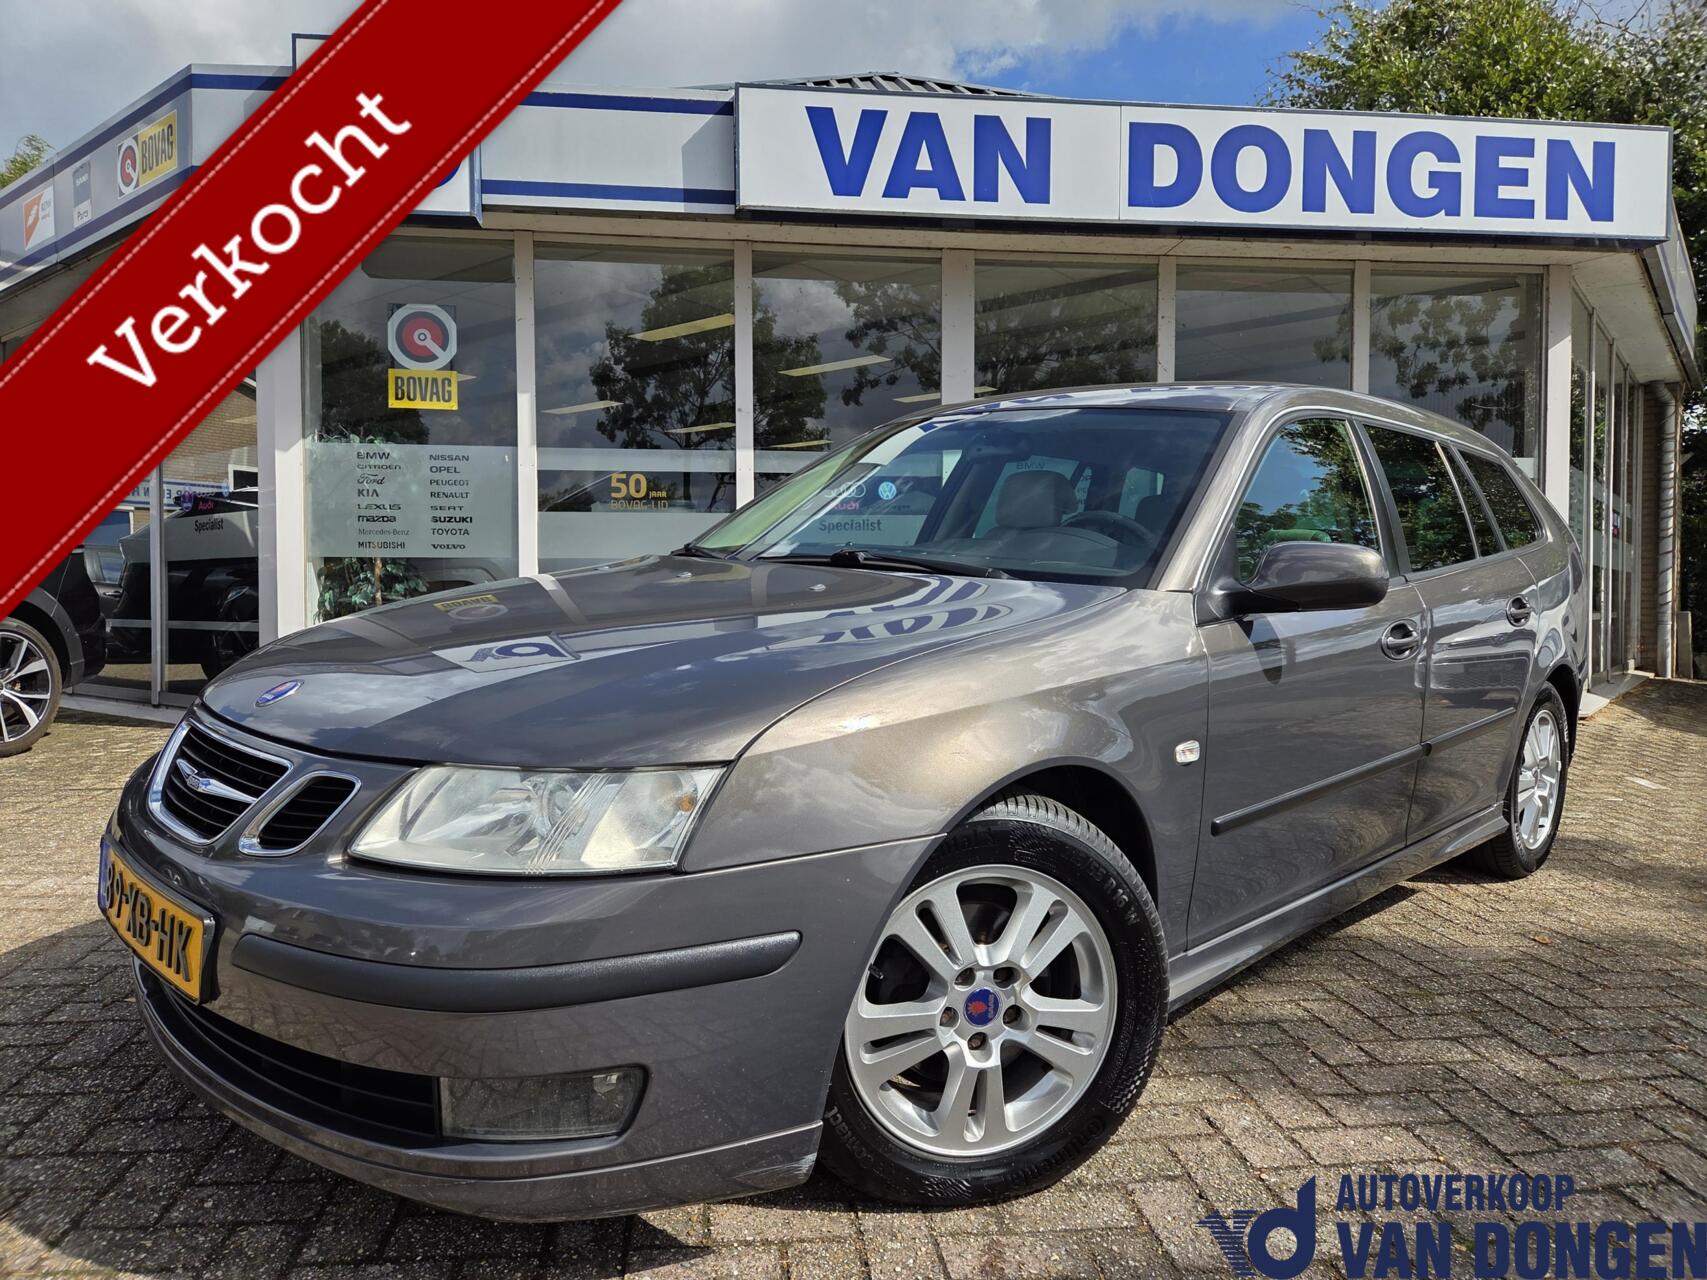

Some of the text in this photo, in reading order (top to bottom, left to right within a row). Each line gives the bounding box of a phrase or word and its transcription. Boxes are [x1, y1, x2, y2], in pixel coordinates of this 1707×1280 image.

[142, 124, 173, 174] BOVAG
[807, 108, 1615, 221] VAN DONGEN
[395, 376, 452, 403] BOVAG
[430, 466, 460, 474] OPEL
[357, 473, 385, 485] Ford
[610, 473, 647, 498] 50
[358, 489, 379, 497] KIA
[430, 491, 470, 499] RENAULT
[198, 501, 215, 510] Audi
[609, 500, 668, 510] BOVAG-LID
[431, 516, 473, 524] SUZUKI
[194, 518, 224, 534] Specialist
[819, 520, 882, 533] Specialist
[431, 528, 470, 536] TOYOTA
[358, 541, 405, 549] MITSUBISHI
[106, 862, 192, 983] 89-XB-HK
